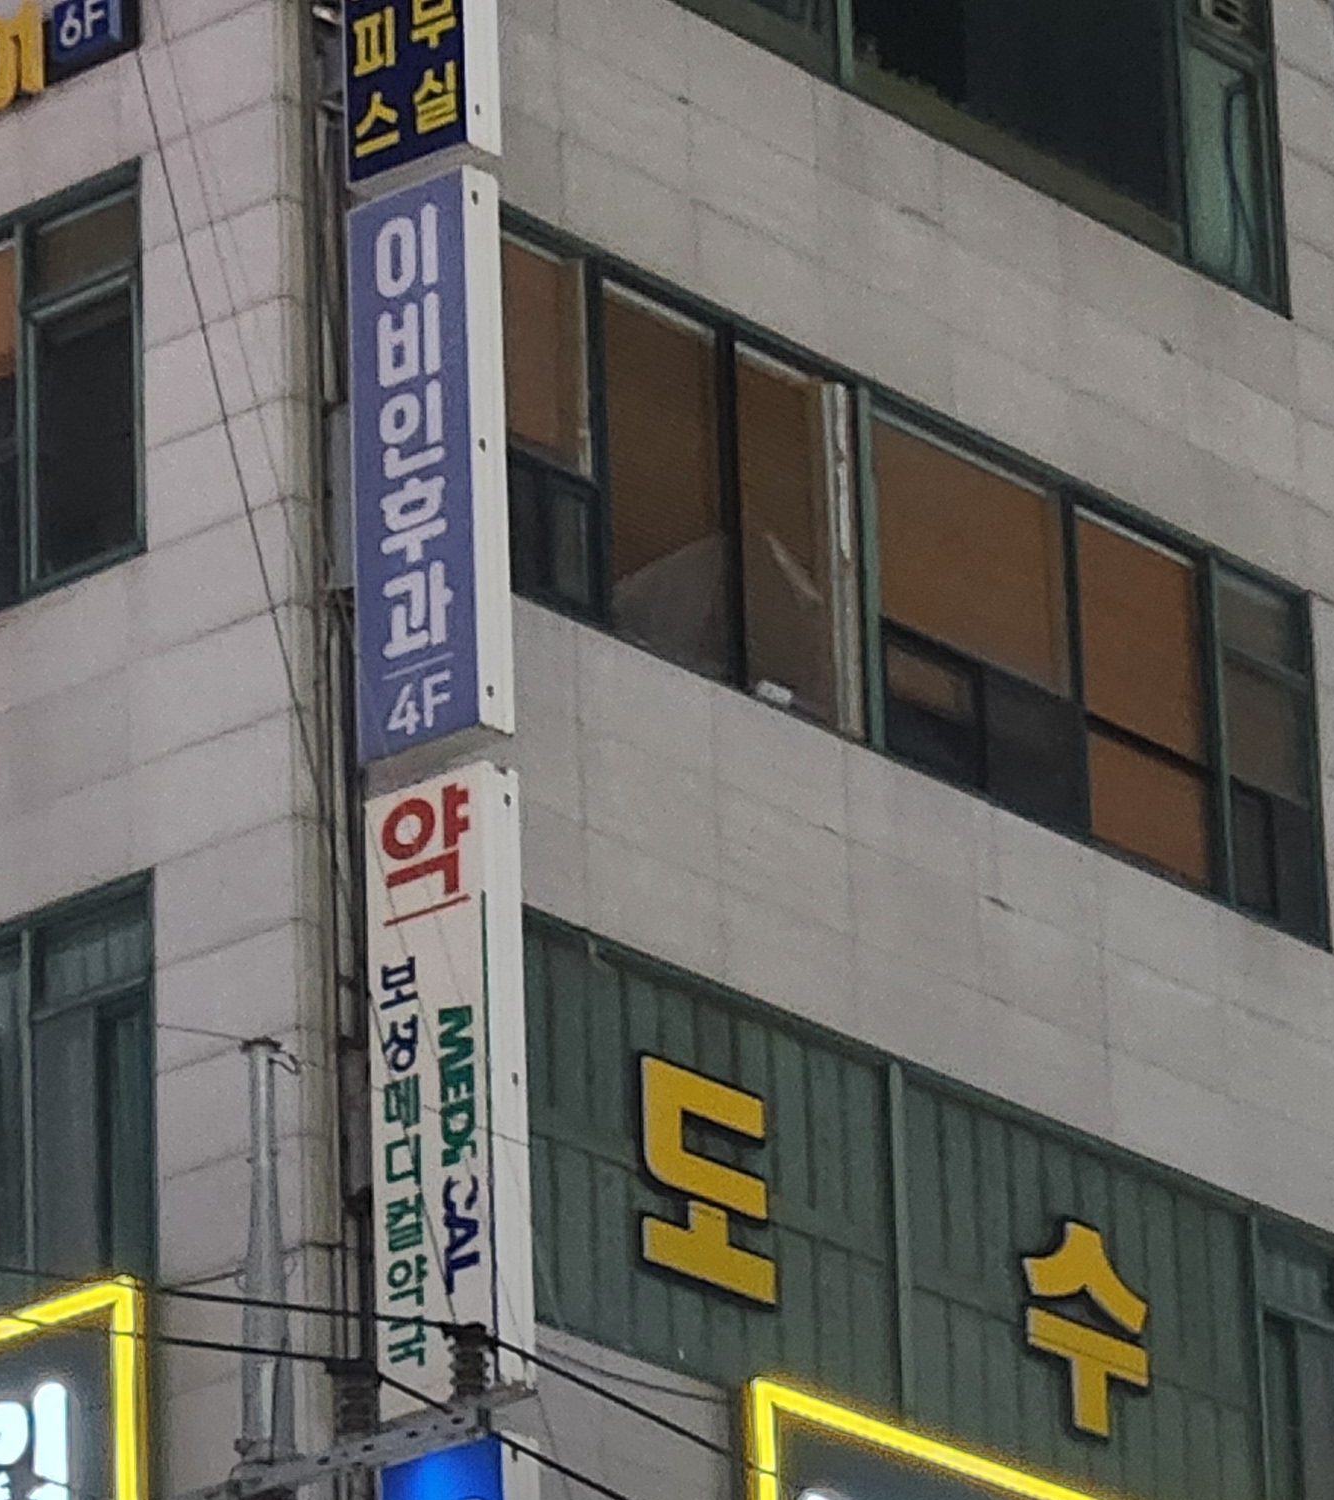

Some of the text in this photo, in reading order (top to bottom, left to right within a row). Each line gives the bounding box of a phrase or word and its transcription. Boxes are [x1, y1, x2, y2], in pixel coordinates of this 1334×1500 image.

[374, 204, 451, 660] 이비인후과
[386, 668, 450, 738] 4F
[381, 782, 470, 895] 약
[641, 1053, 1150, 1438] 도수
